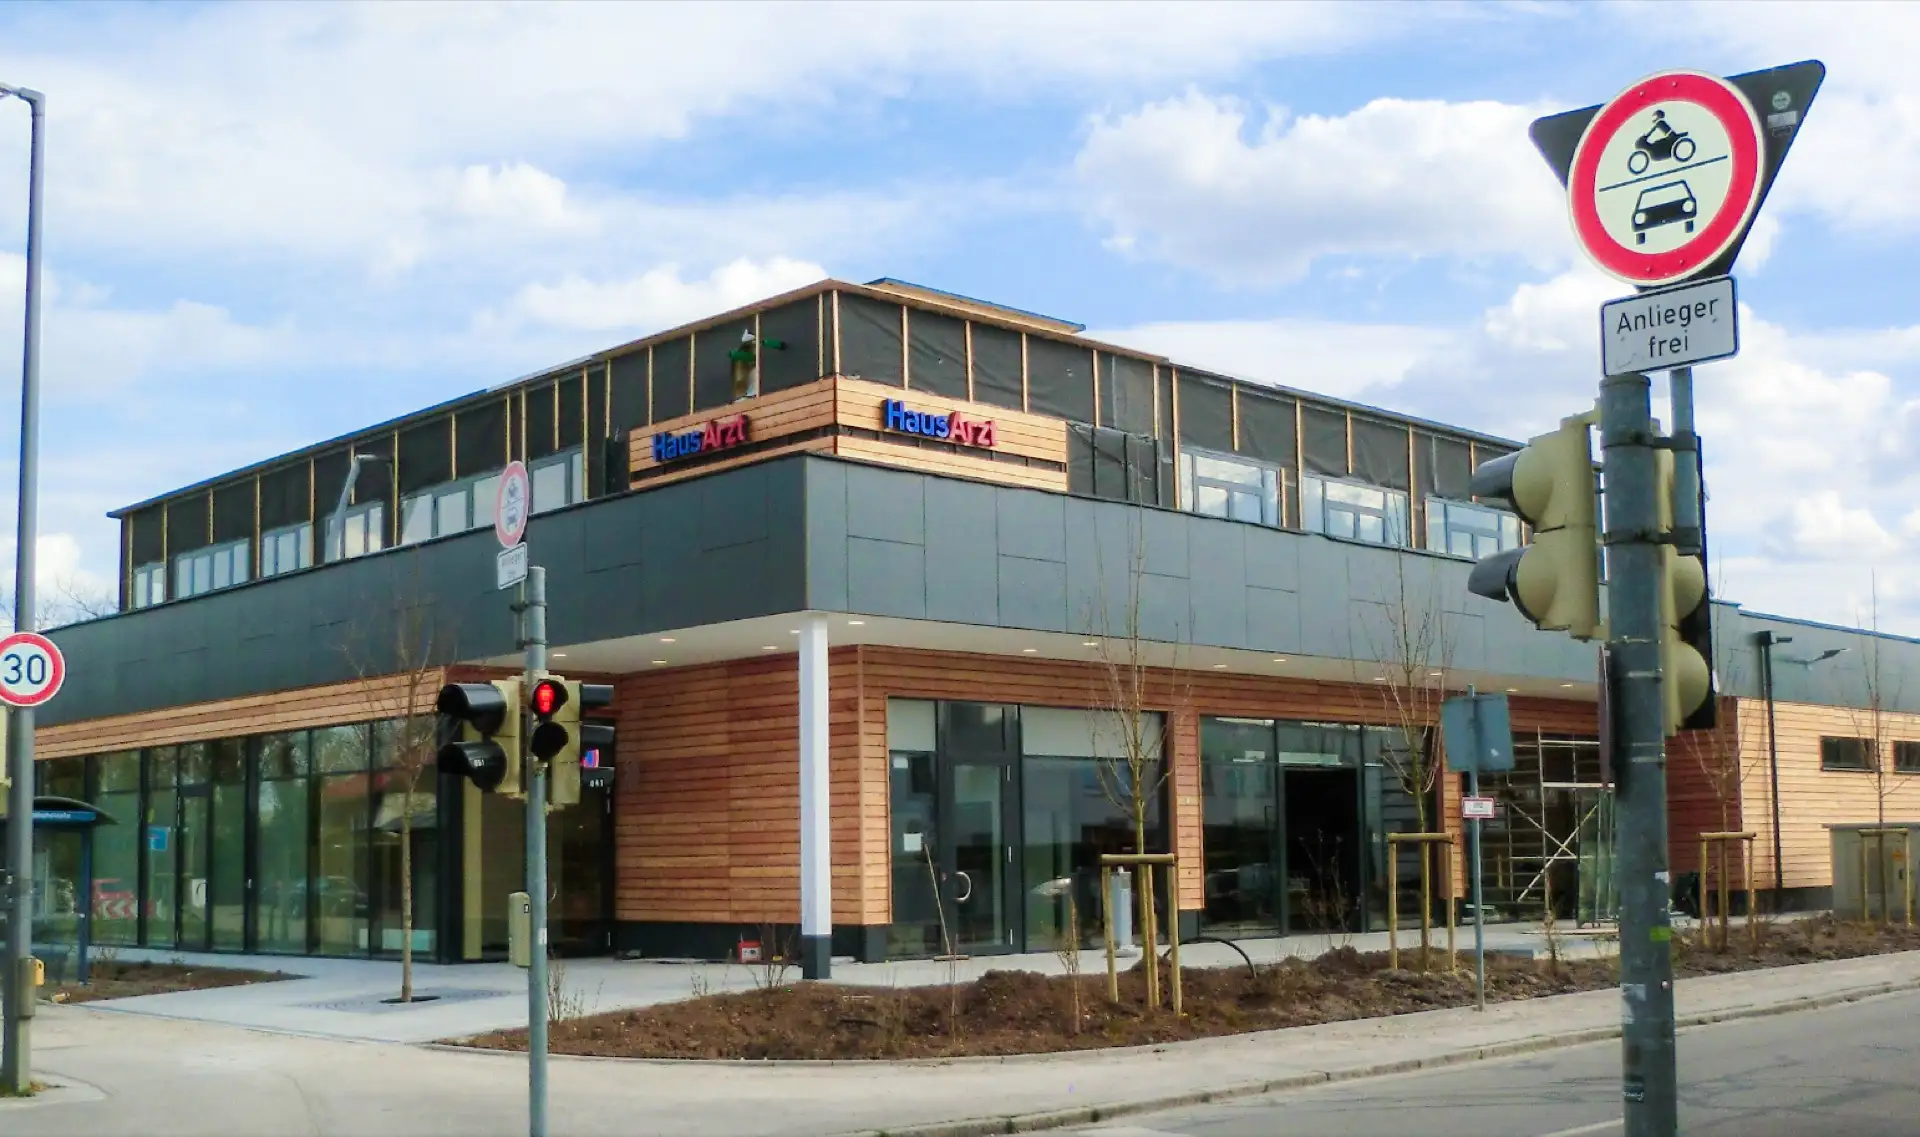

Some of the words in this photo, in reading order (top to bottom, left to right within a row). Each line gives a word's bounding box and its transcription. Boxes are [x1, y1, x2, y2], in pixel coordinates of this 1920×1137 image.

[1616, 298, 1719, 335] Anlieger
[1648, 329, 1689, 358] frei
[651, 413, 748, 463] HausArzt
[884, 398, 997, 447] HausArzt
[4, 653, 47, 686] 30
